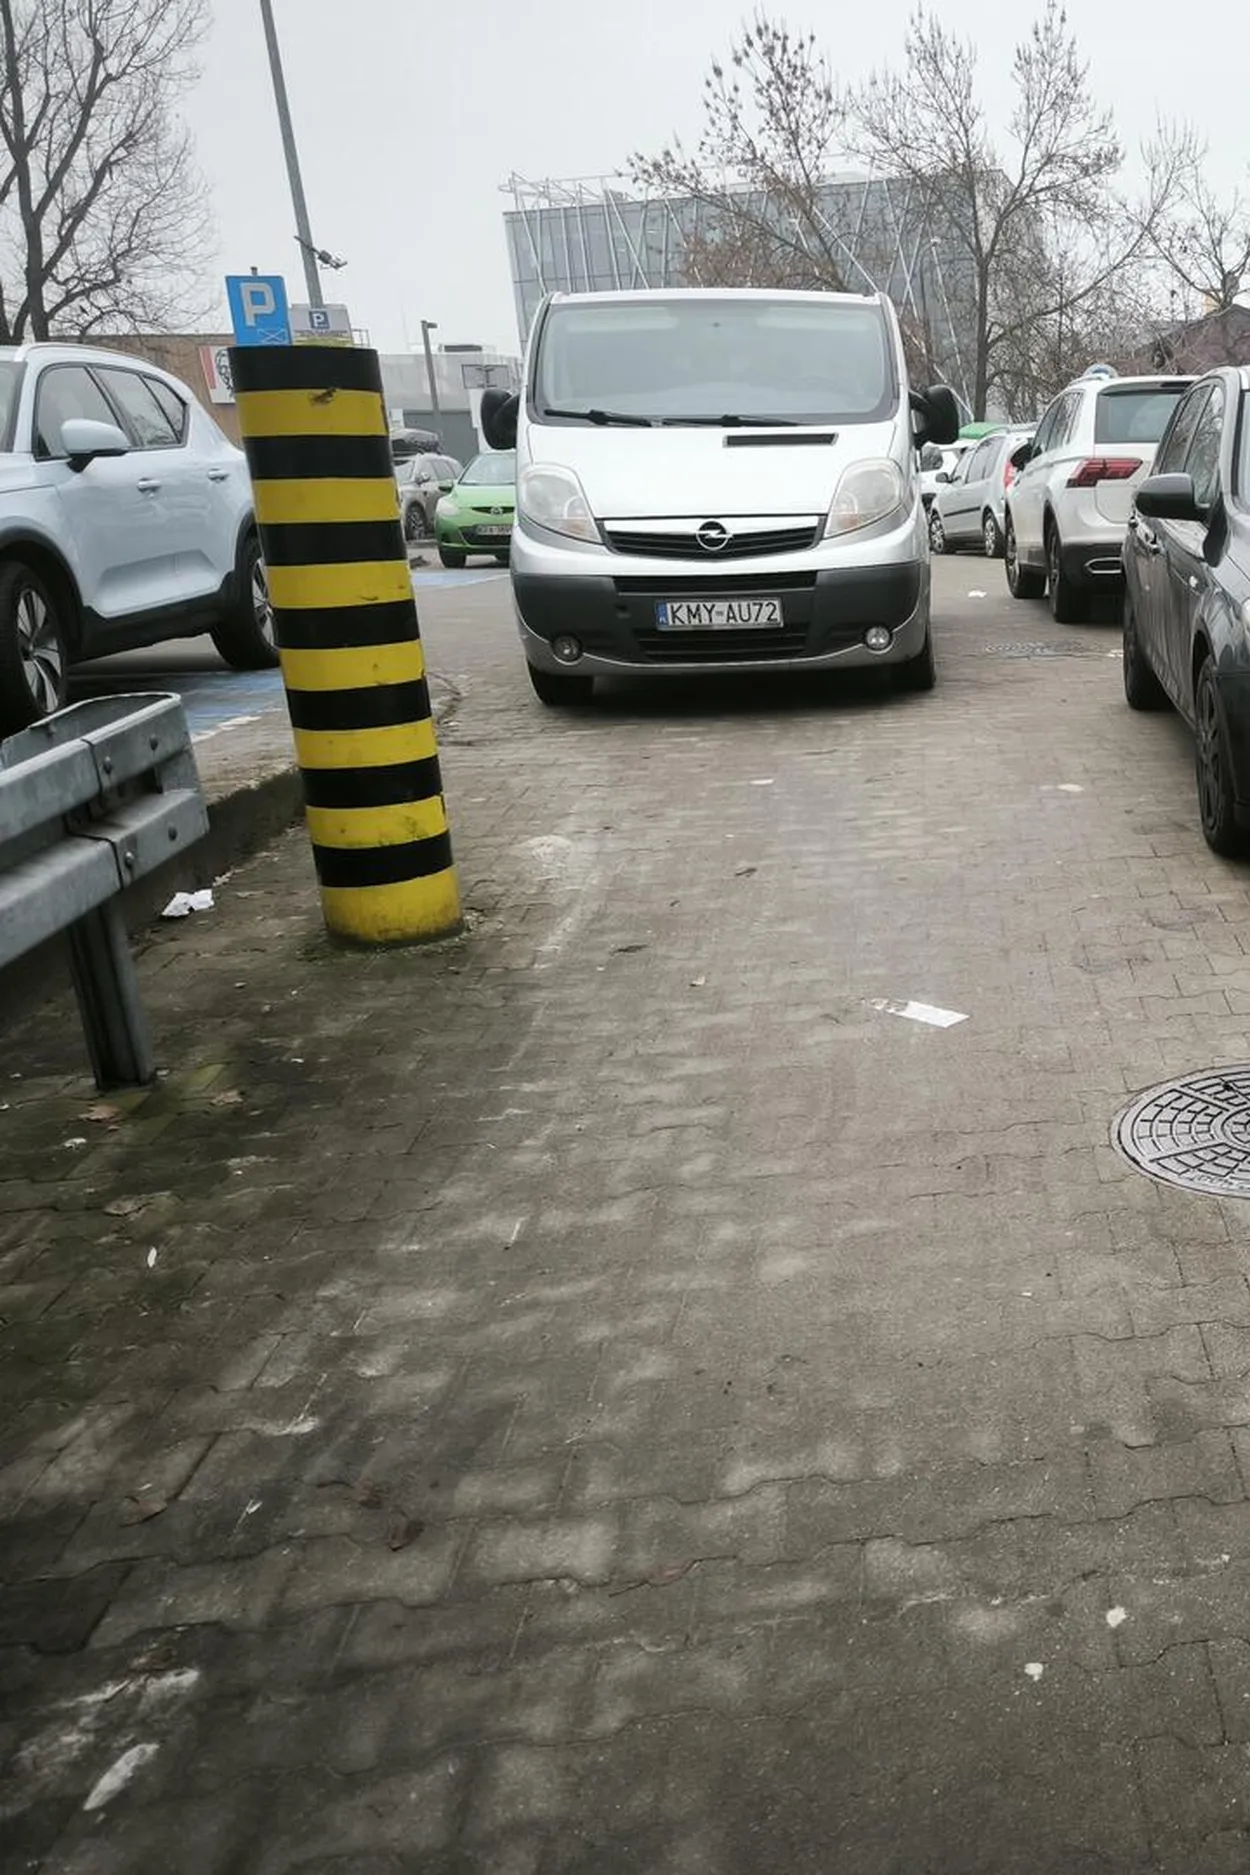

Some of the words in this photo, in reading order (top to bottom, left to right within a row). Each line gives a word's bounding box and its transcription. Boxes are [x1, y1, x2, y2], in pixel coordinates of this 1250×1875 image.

[241, 283, 276, 327] P
[312, 312, 325, 327] P
[670, 603, 716, 625] KMY
[726, 602, 779, 623] AU72
